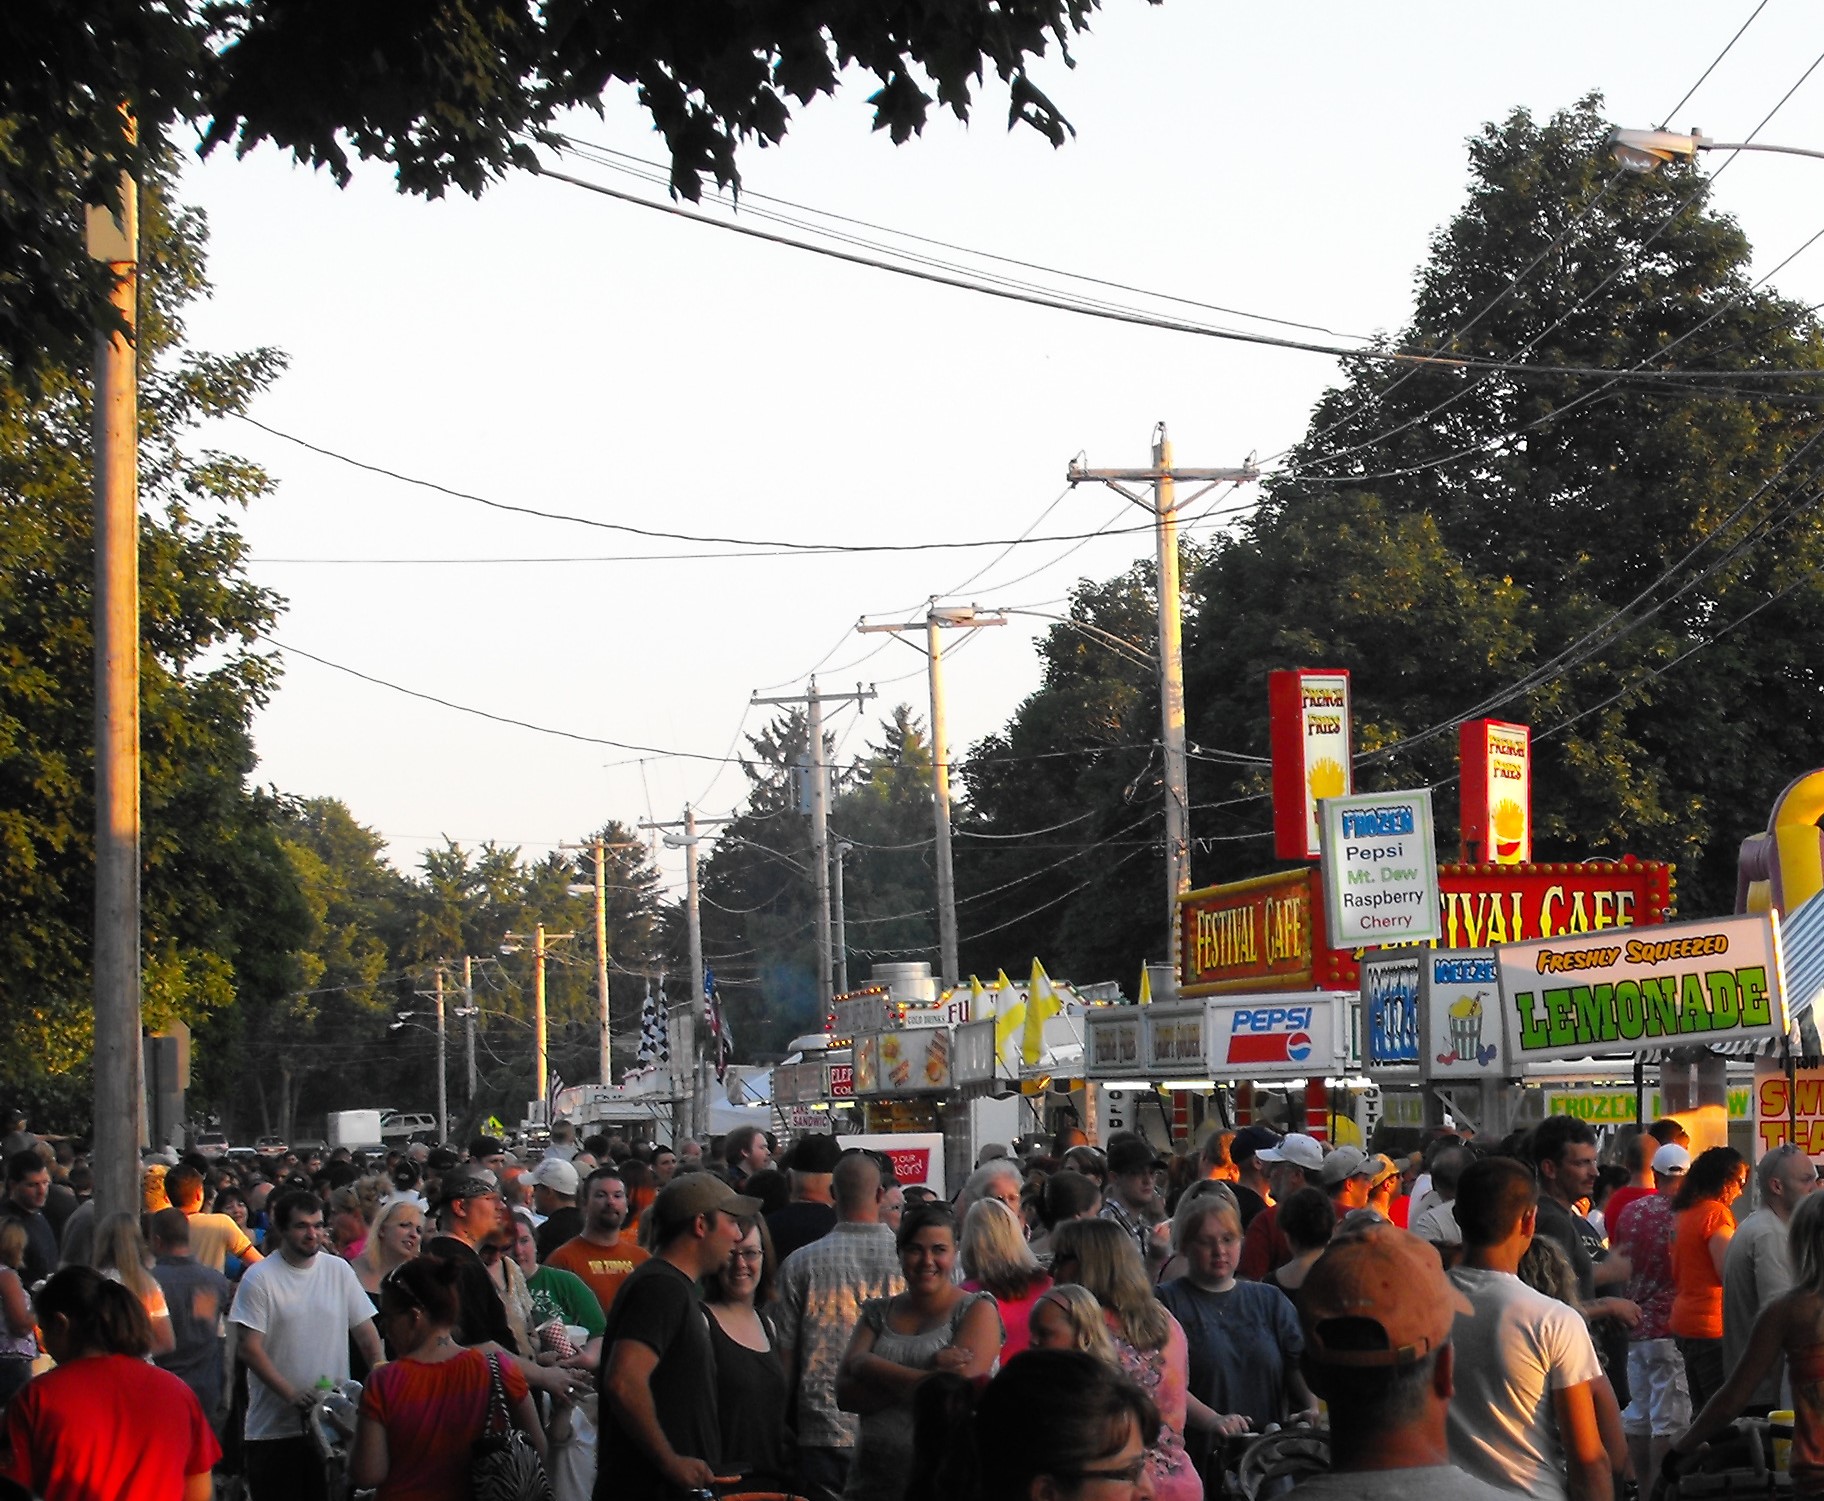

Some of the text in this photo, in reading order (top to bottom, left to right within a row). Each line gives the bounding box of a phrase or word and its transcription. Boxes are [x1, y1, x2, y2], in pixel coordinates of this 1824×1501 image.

[1342, 805, 1414, 839] FROZEN
[1346, 843, 1403, 862] Pepsi
[1347, 867, 1418, 884] Mt. Dew
[1343, 890, 1424, 908] Raspberry
[1196, 897, 1301, 976] FESTIVAL CAFE
[1360, 915, 1412, 930] Cherry
[1536, 934, 1729, 975] FRESHLY SQUEEZED
[1232, 1007, 1313, 1032] PEPSI
[1515, 966, 1774, 1051] LEMONADE
[1550, 1091, 1637, 1122] FROZEN
